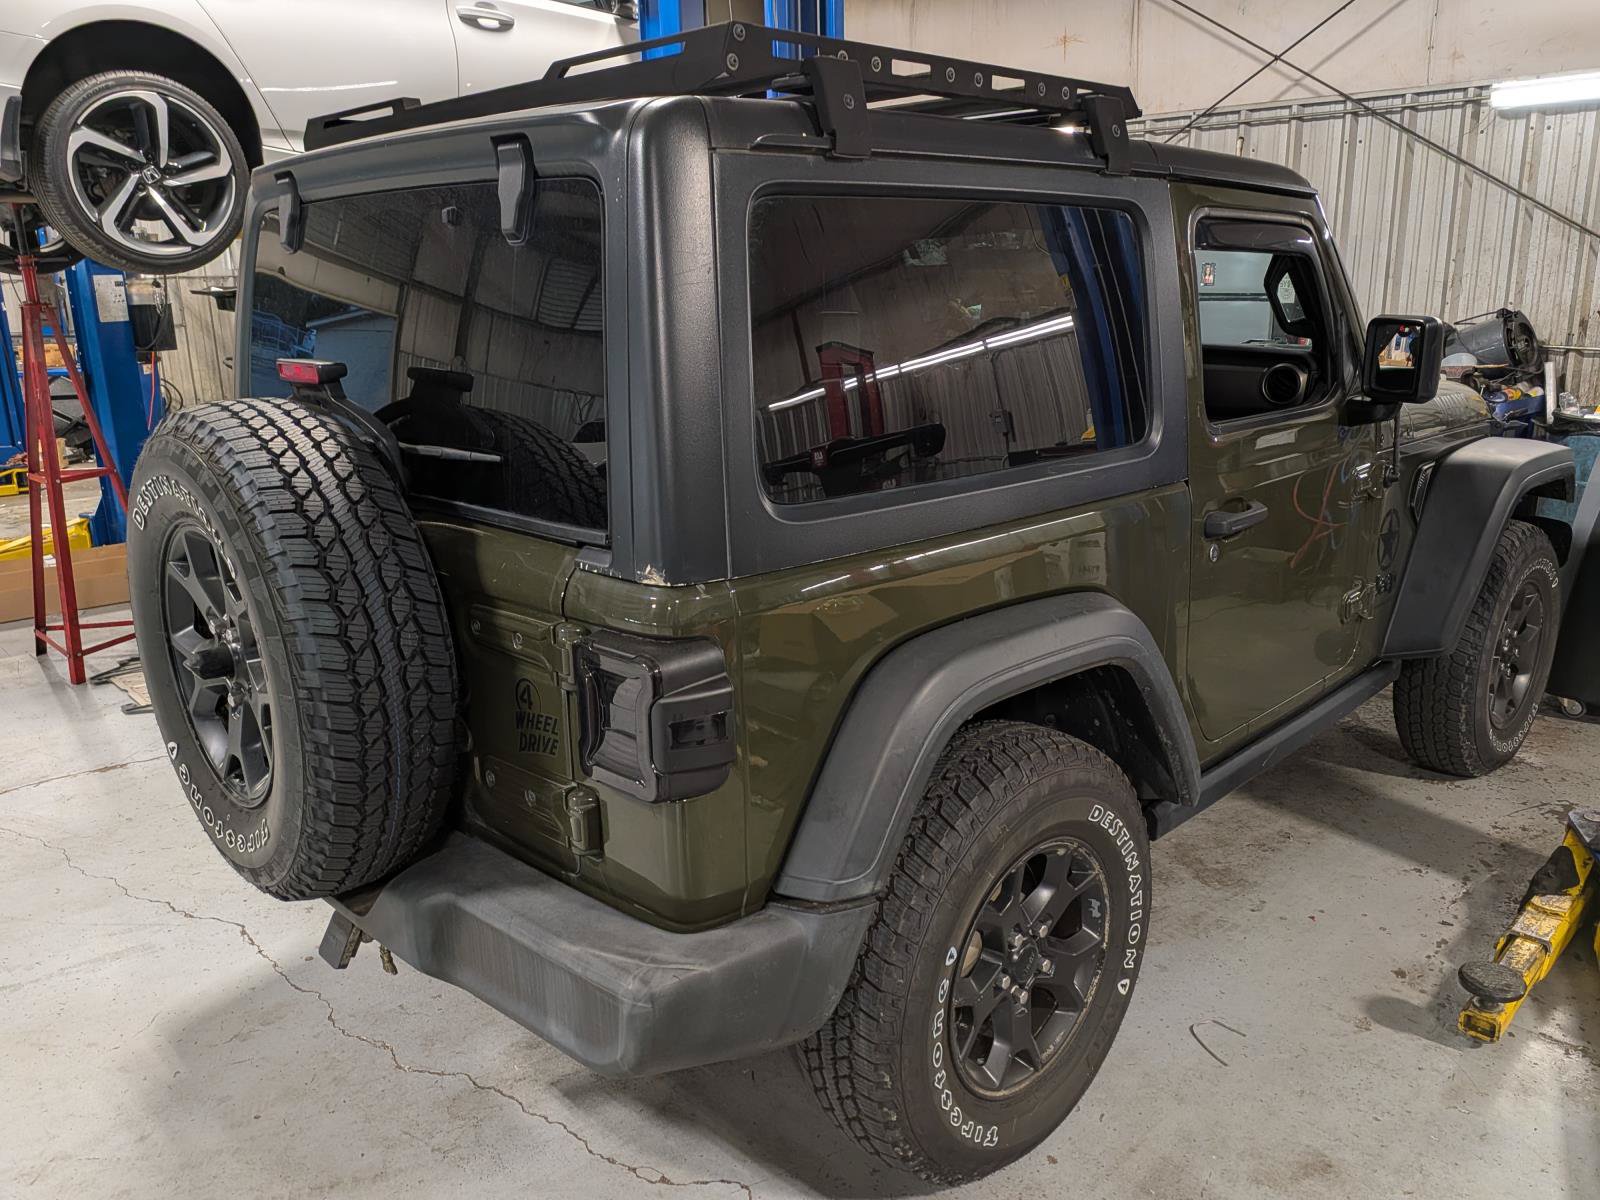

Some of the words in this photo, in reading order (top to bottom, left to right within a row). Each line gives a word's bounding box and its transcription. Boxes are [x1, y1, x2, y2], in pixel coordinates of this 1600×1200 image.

[515, 710, 560, 736] WHEEL
[519, 731, 560, 756] DRIVE
[1087, 803, 1144, 970] DESTINATION
